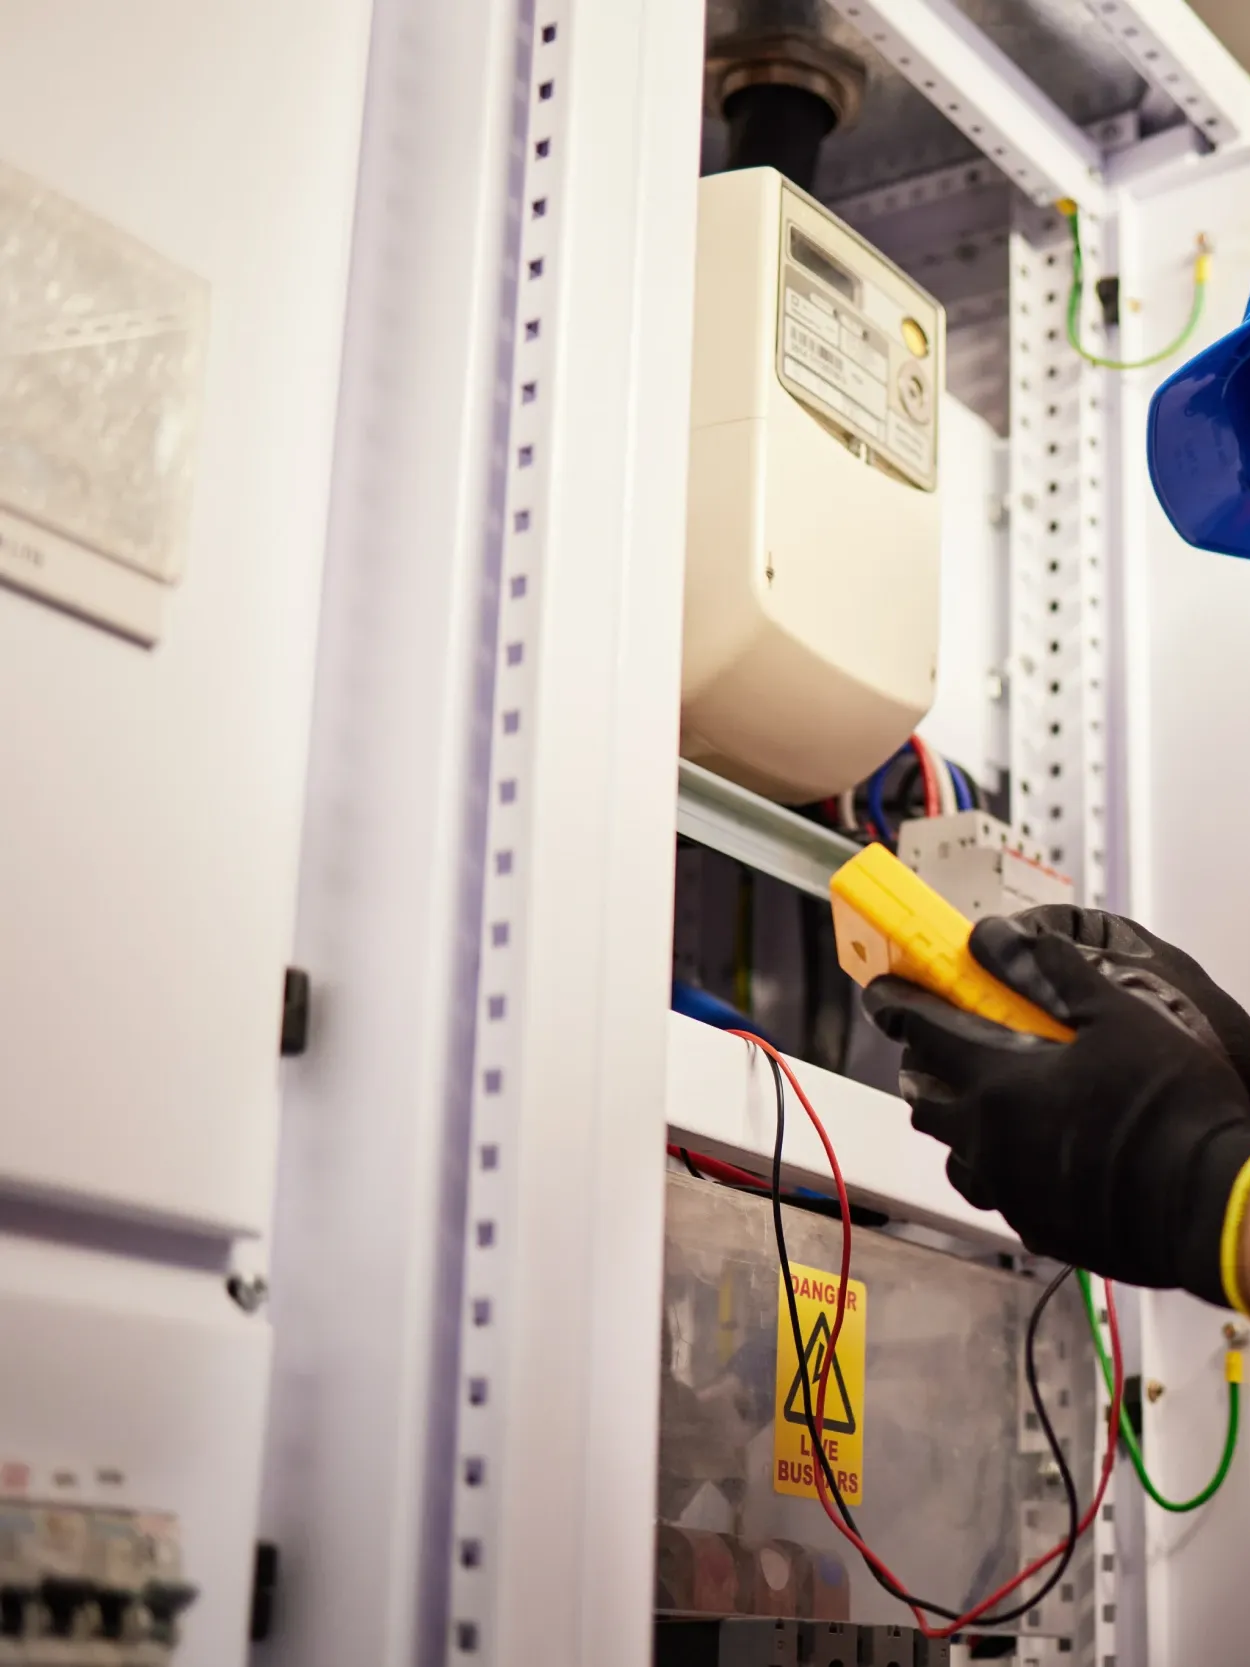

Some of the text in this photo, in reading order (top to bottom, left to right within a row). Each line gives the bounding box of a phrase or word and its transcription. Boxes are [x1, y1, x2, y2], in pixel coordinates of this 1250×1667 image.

[790, 1274, 857, 1311] DANGR
[801, 1434, 838, 1461] LE
[778, 1460, 858, 1493] BUSRS
